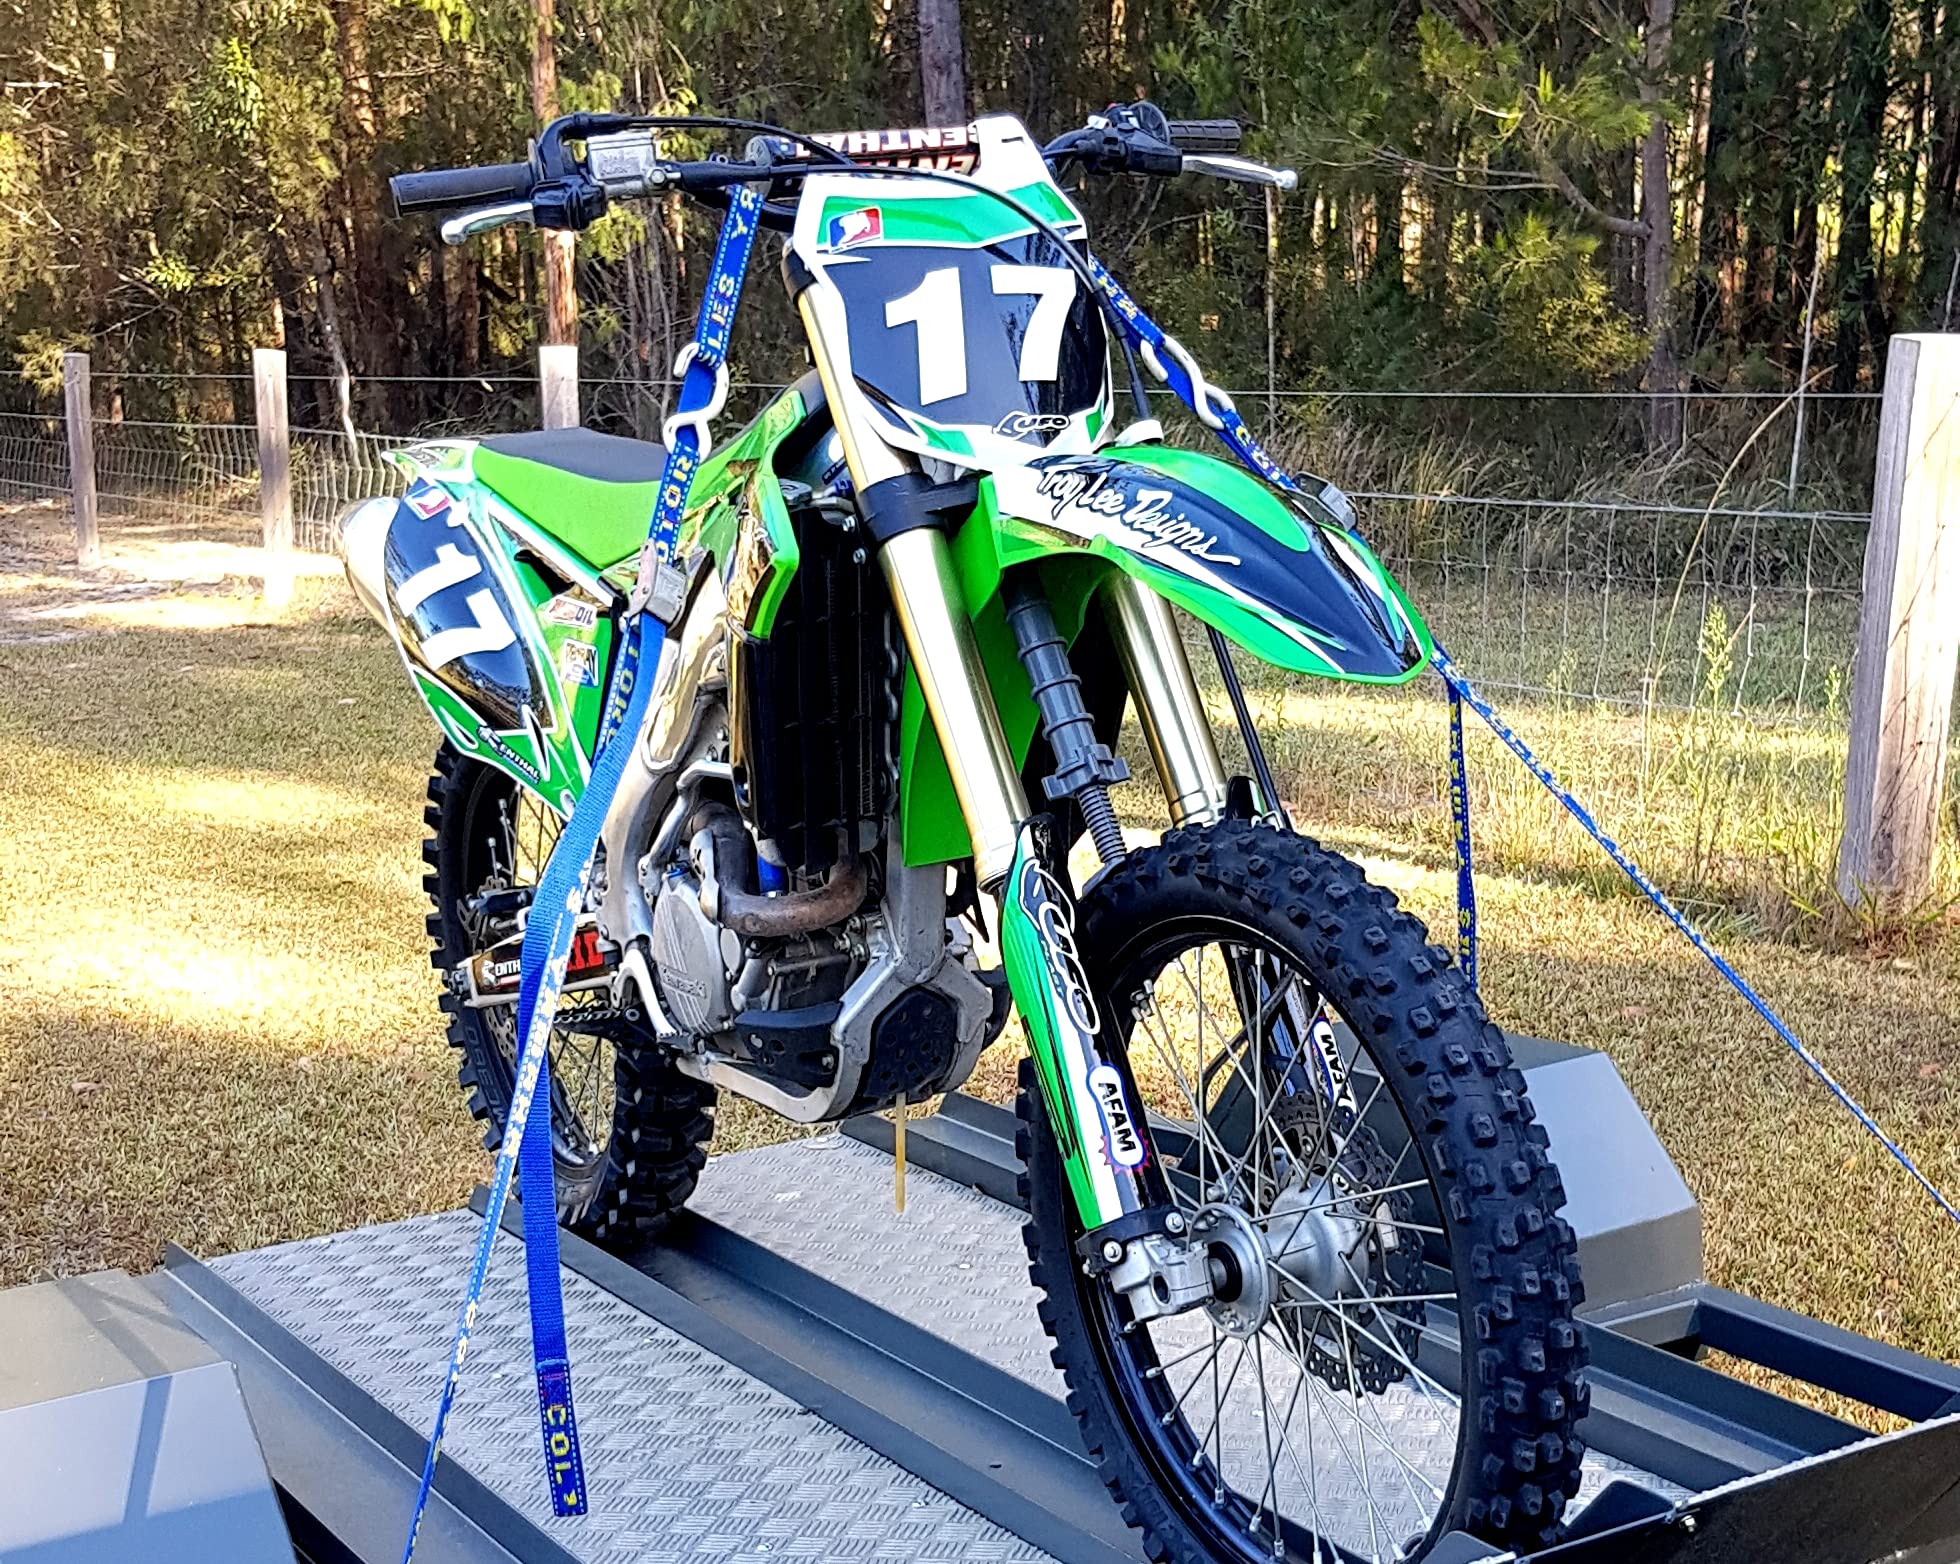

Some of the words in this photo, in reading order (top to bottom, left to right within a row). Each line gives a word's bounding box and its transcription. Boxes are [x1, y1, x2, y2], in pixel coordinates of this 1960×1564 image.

[885, 264, 1077, 406] 17
[1037, 465, 1086, 520] Troy
[1076, 472, 1125, 517] Lee
[1121, 489, 1241, 566] Designs
[396, 543, 517, 671] 17
[575, 607, 593, 625] OIL
[1038, 902, 1100, 1035] UFO
[1098, 1082, 1136, 1152] AFAM
